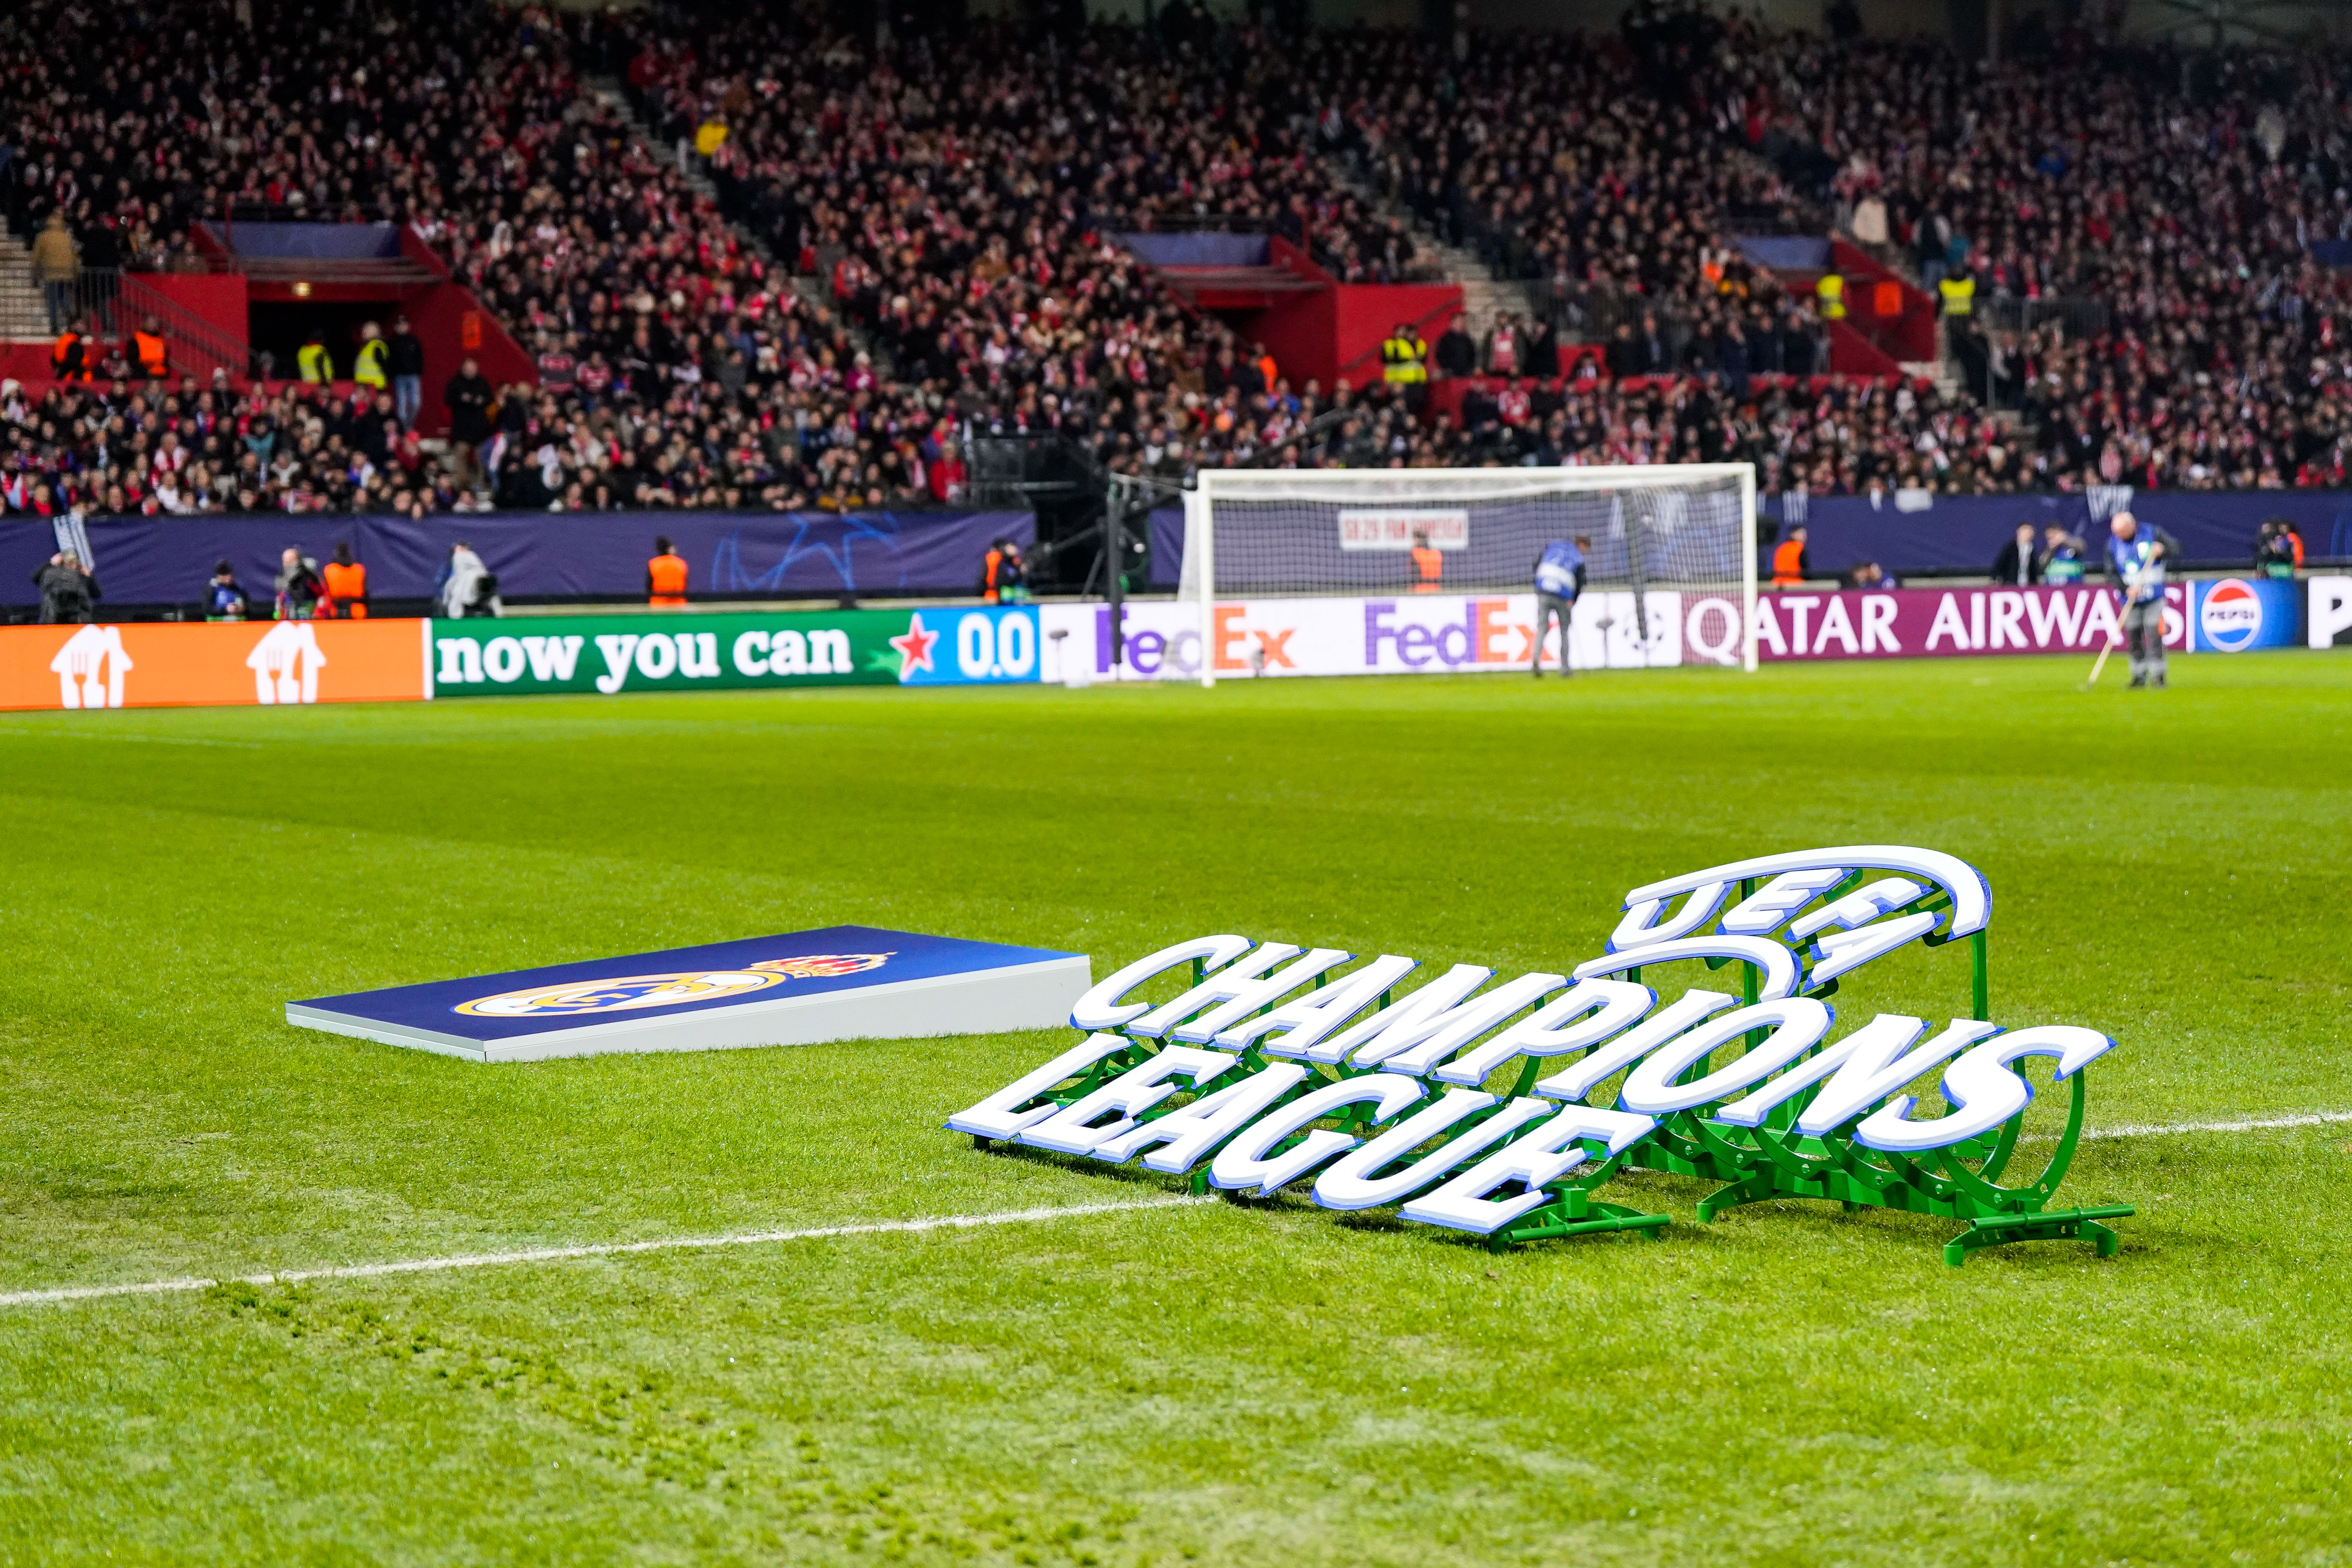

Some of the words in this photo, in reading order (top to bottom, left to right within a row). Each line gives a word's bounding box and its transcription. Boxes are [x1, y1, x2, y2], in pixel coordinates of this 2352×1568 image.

[436, 635, 585, 684] now
[595, 632, 721, 694] you
[732, 628, 854, 677] can
[957, 611, 1035, 678] 0.0
[1686, 595, 1902, 666] QATAR
[1925, 587, 2185, 651] AIRWAS
[1605, 867, 1947, 993] UEFA
[1069, 934, 2118, 1152] CHAMPIONS
[942, 1032, 1663, 1235] LEAGUE
